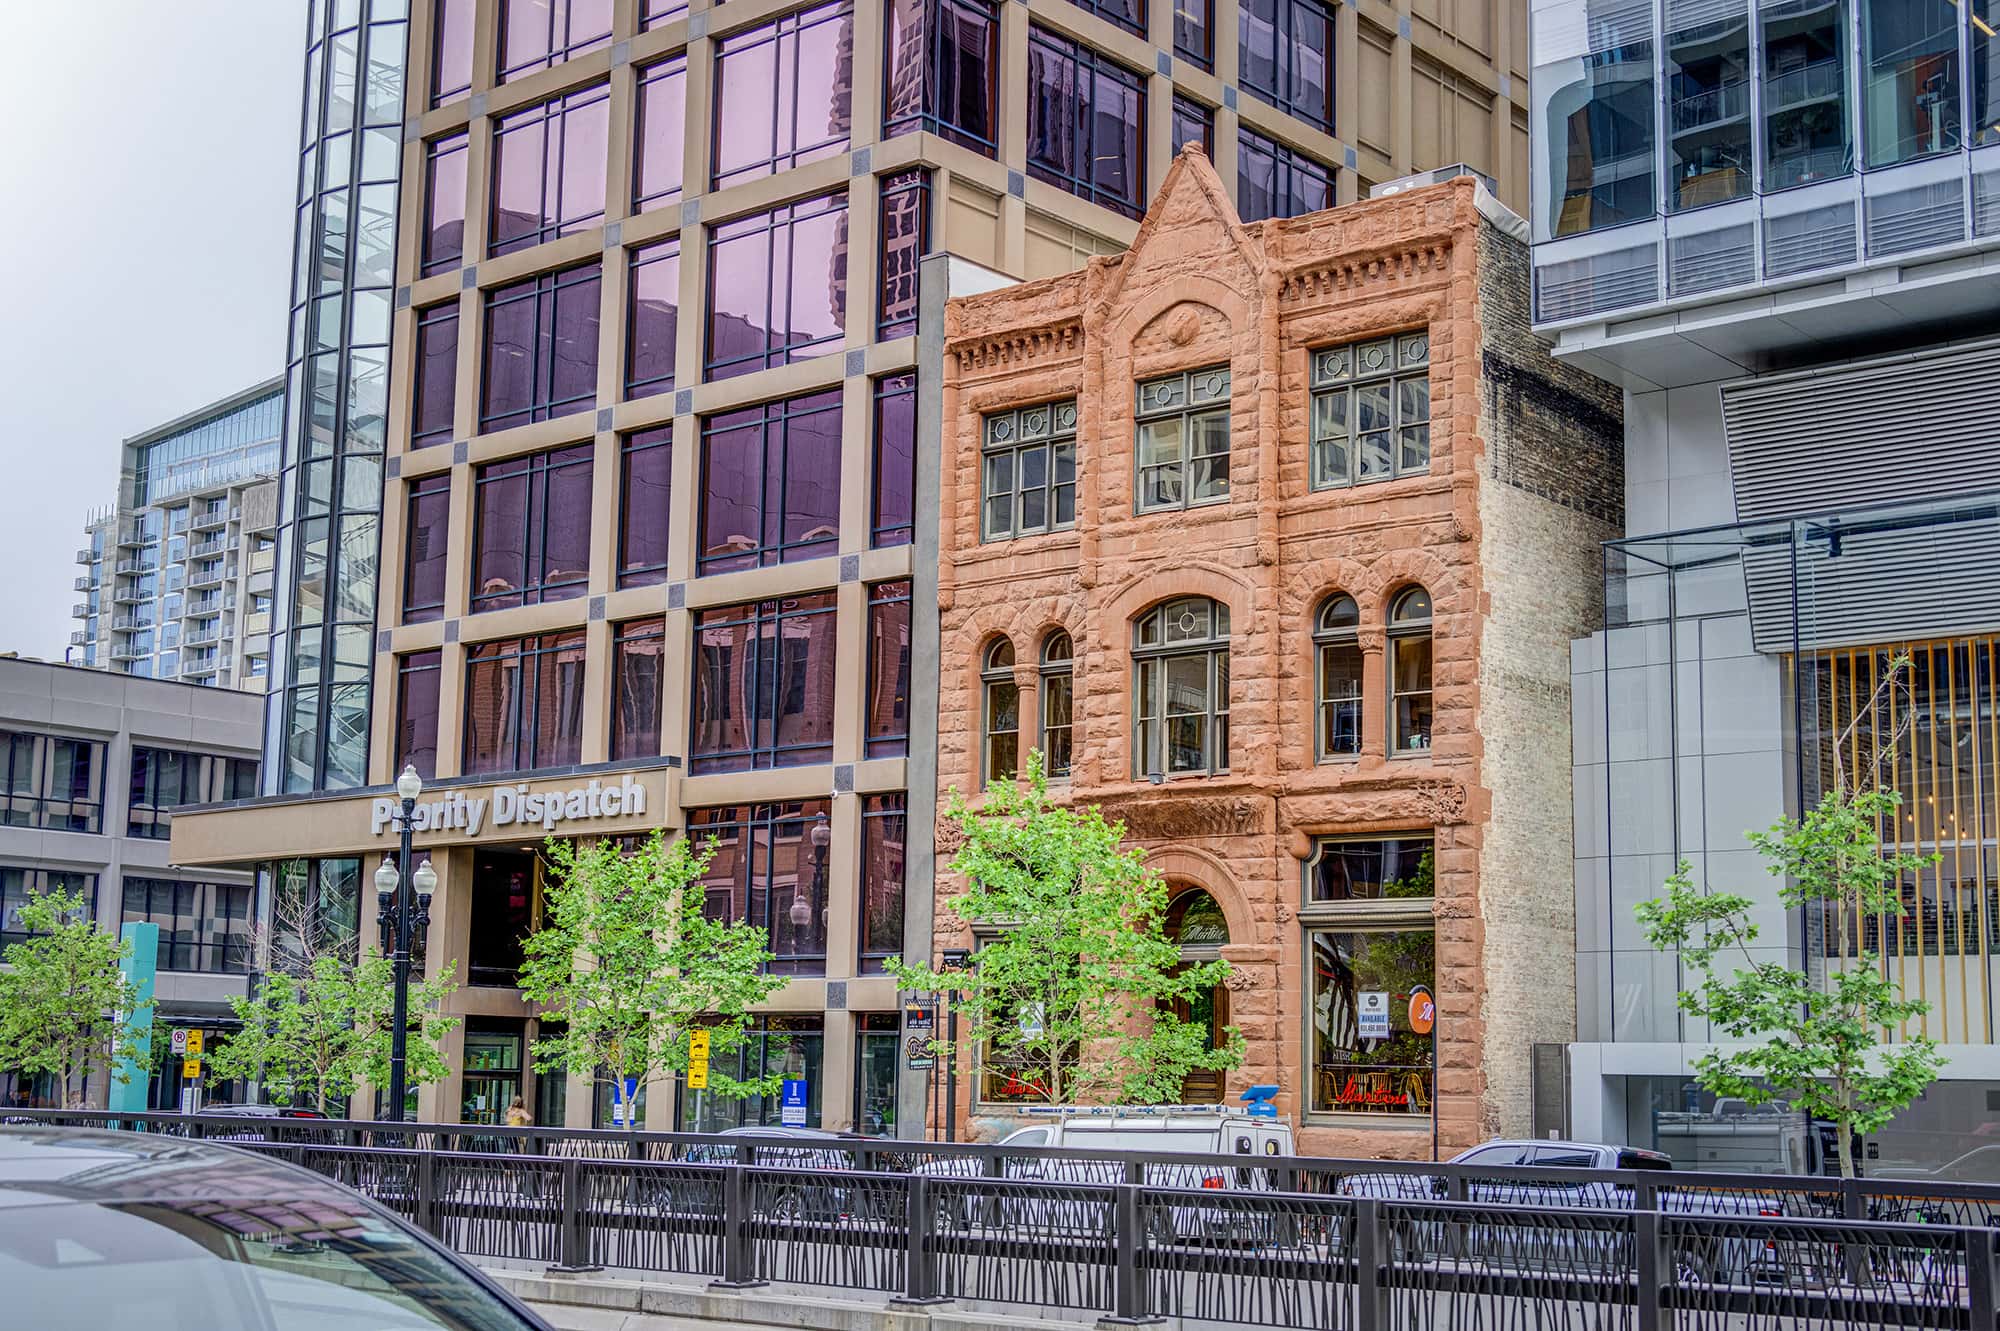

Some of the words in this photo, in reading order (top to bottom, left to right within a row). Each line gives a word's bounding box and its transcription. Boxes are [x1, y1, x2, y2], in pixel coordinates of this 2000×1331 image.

[371, 791, 488, 835] Prority
[492, 775, 647, 830] Dispatch
[1336, 1073, 1409, 1104] Martine
